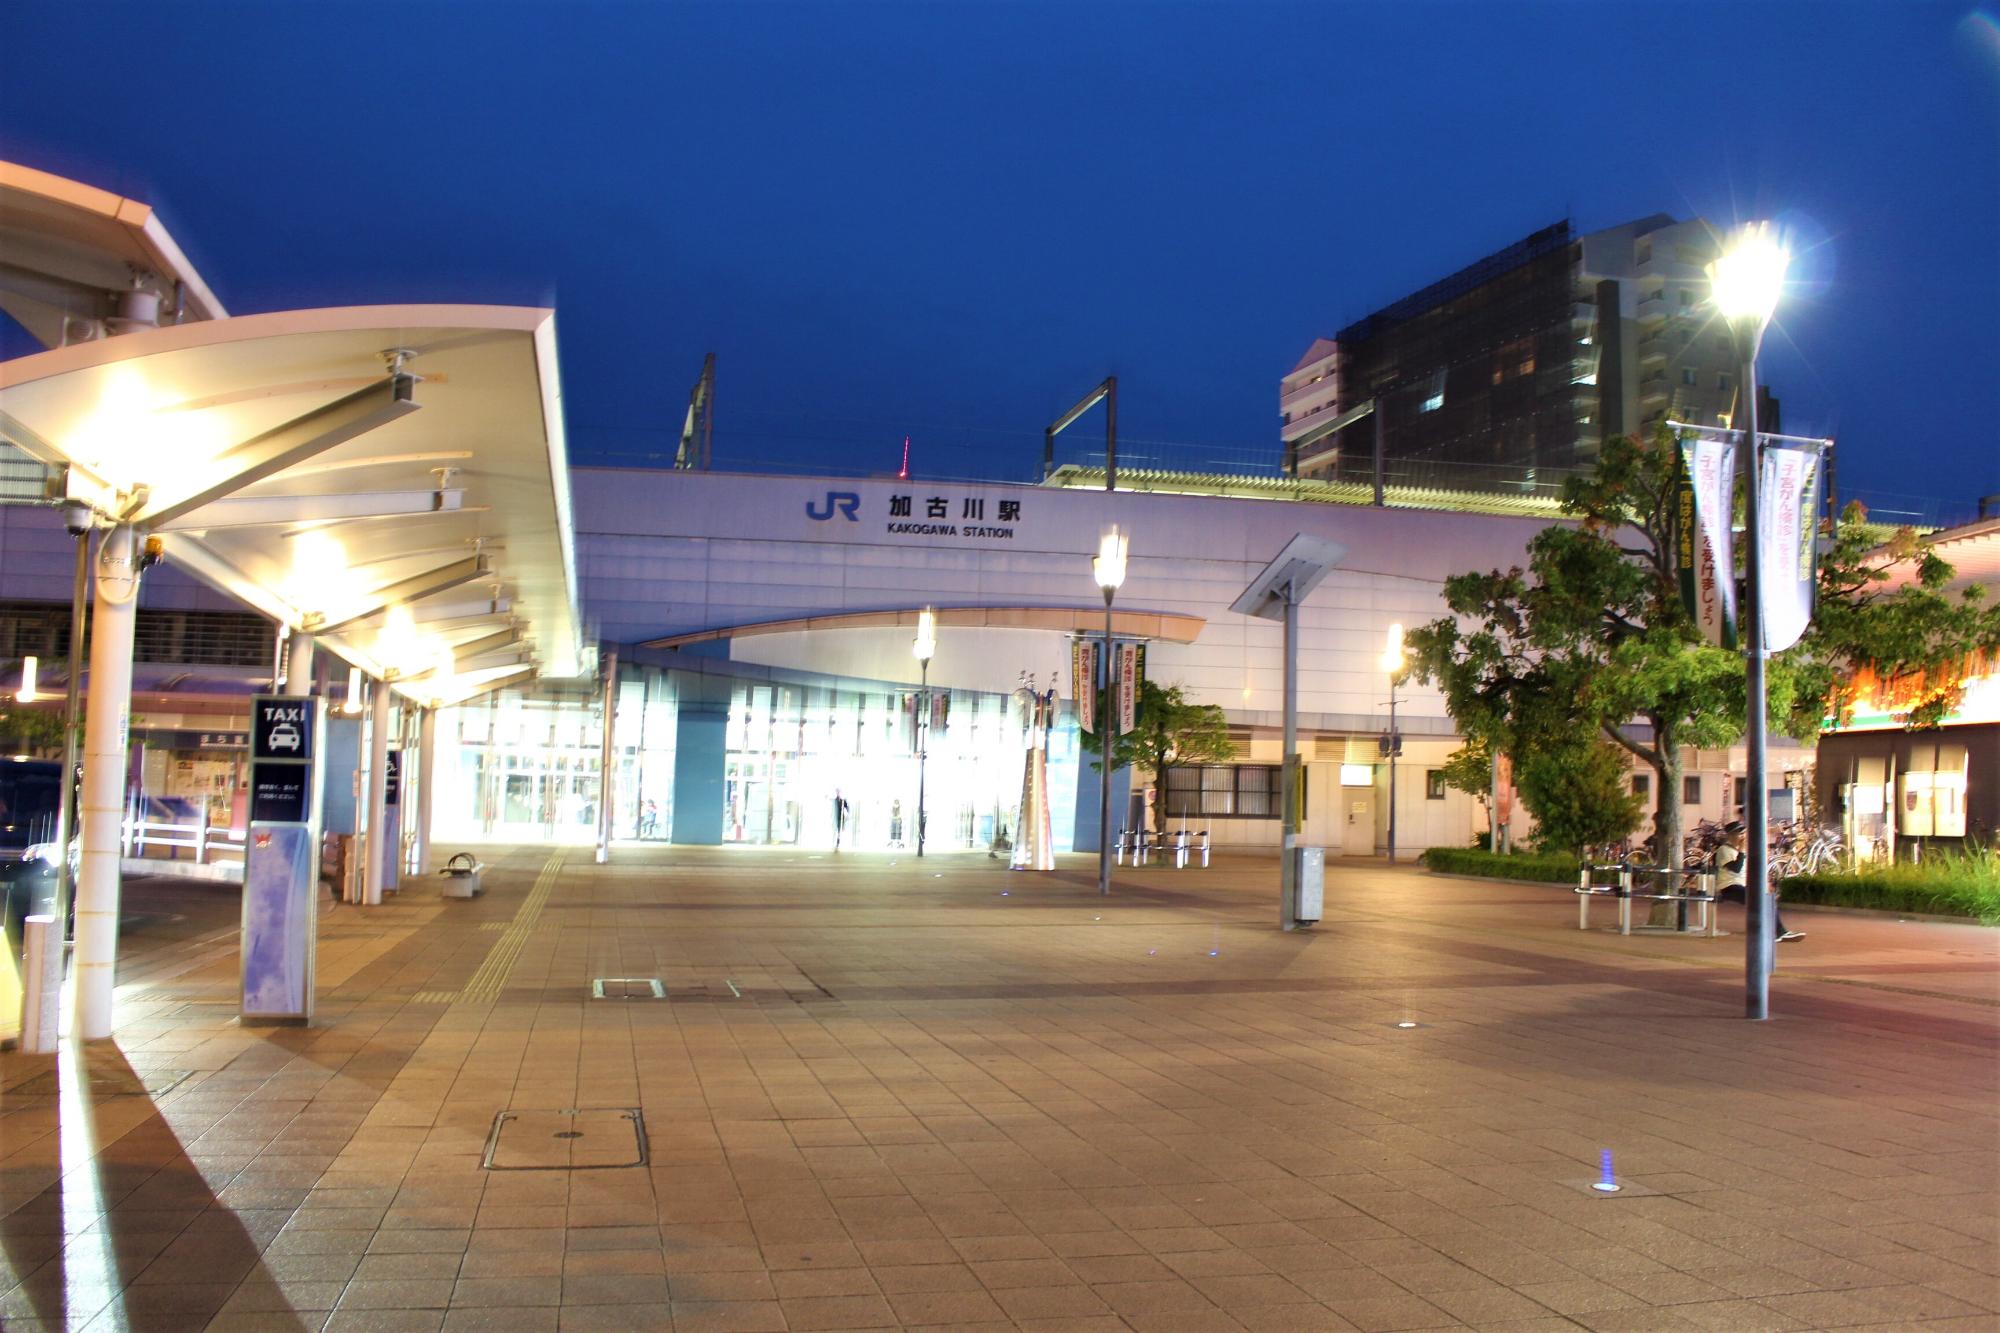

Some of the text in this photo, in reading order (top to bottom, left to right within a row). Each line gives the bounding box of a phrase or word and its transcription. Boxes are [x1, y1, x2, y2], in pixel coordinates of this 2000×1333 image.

[805, 491, 861, 522] JR
[889, 494, 1021, 522] 加古川駅
[887, 523, 1013, 539] KAKOGAWA STATION
[264, 707, 306, 722] TAXI
